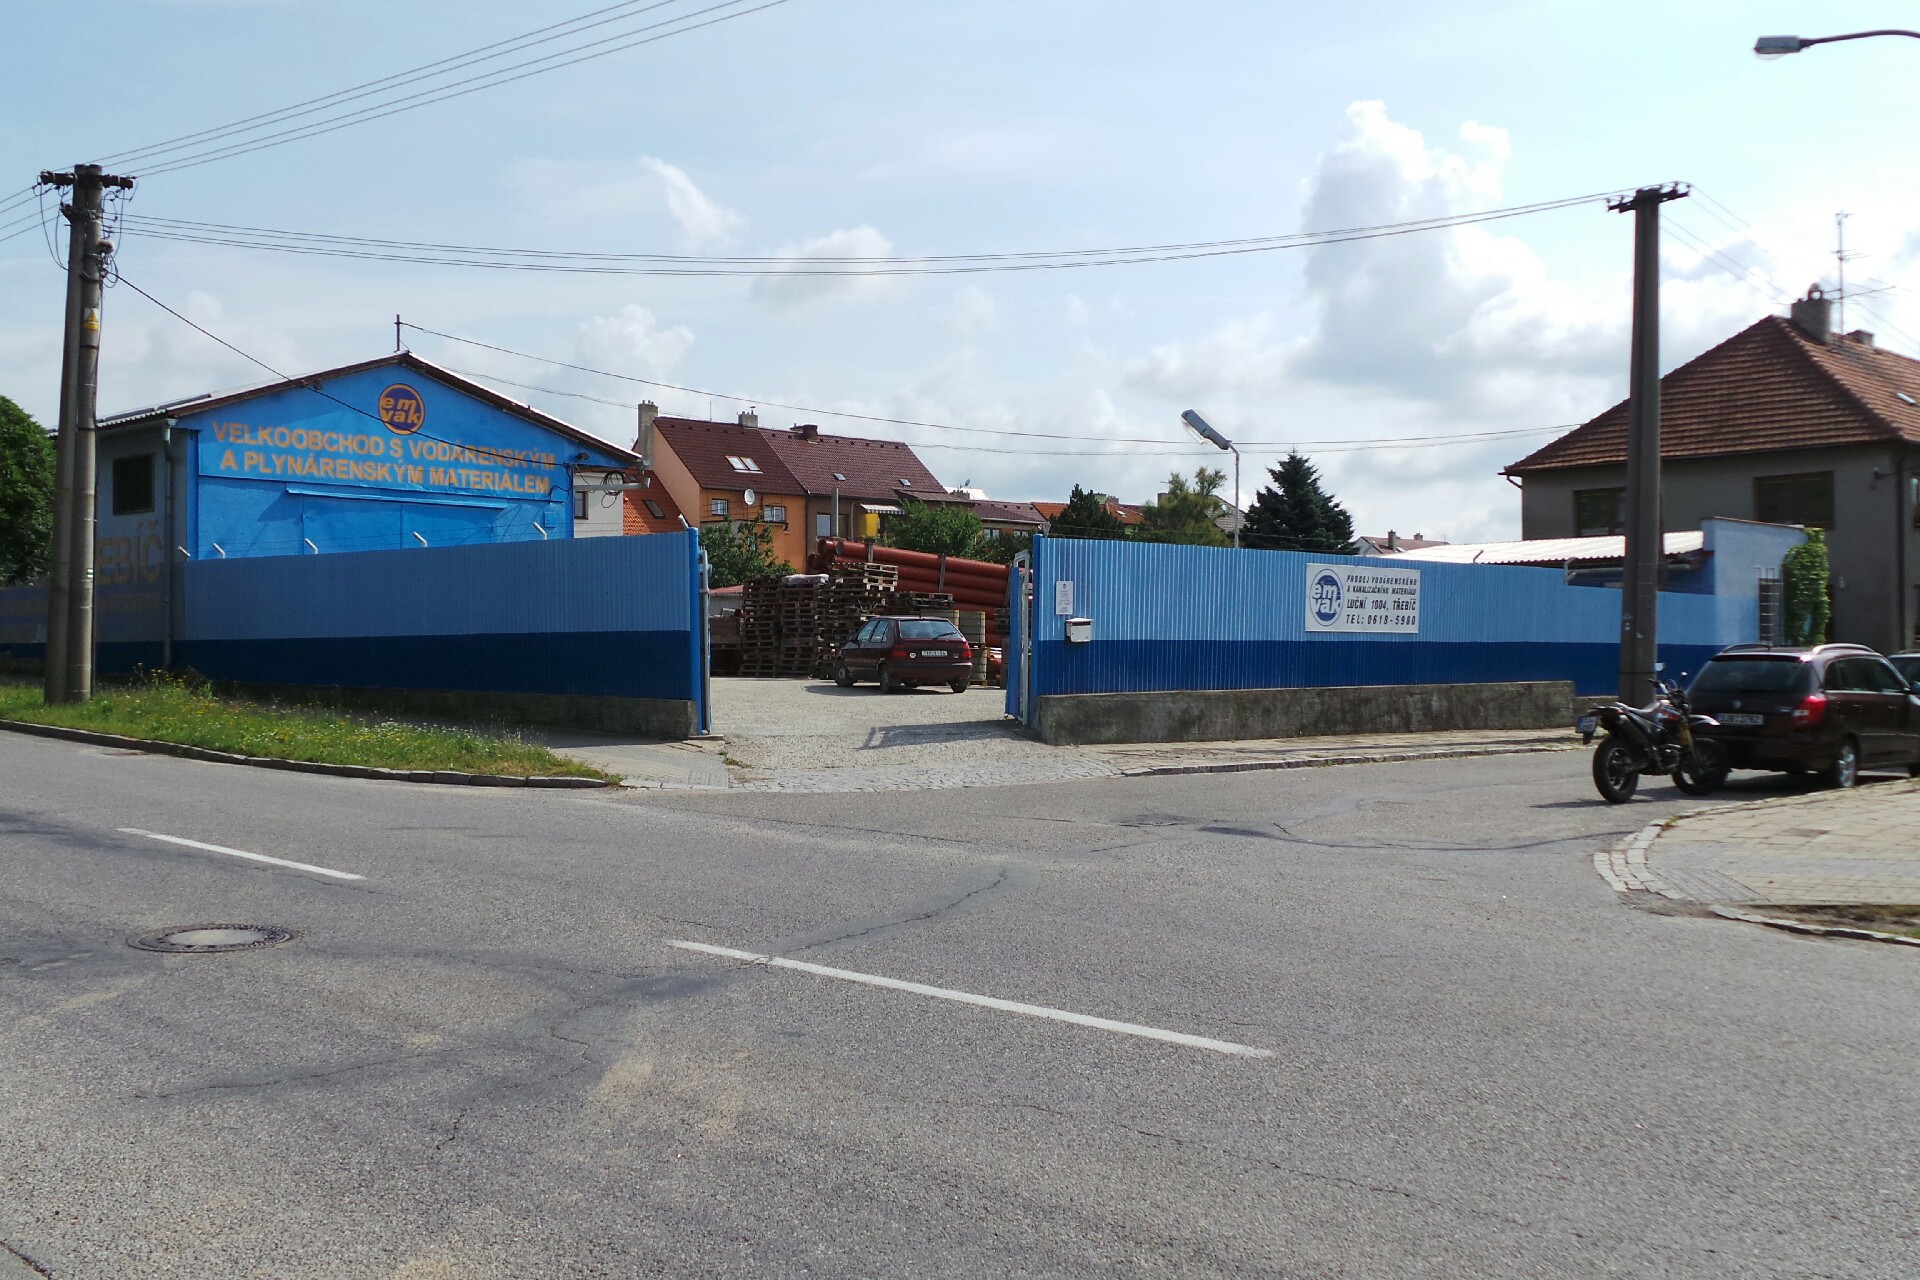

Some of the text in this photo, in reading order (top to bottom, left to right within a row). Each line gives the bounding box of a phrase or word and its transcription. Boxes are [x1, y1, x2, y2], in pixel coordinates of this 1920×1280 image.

[381, 397, 417, 410] em
[381, 410, 421, 424] vak
[213, 422, 557, 471] VELKOOBCHOD S VODÁRENSKÝM
[220, 450, 551, 494] A PLYNÁRENSKÝM MATERIÁLEM
[96, 520, 163, 584] EBÍČ
[1346, 574, 1417, 586] PRODEJ VODÁRENSKÉHO
[1312, 582, 1338, 600] em
[1346, 585, 1351, 593] A
[1352, 585, 1390, 595] KANALIZAČNÍHO
[1311, 598, 1341, 614] vak
[1346, 596, 1417, 611] LUČNÍ 1004, TŘEBÍČ
[1346, 614, 1364, 625] TEL:
